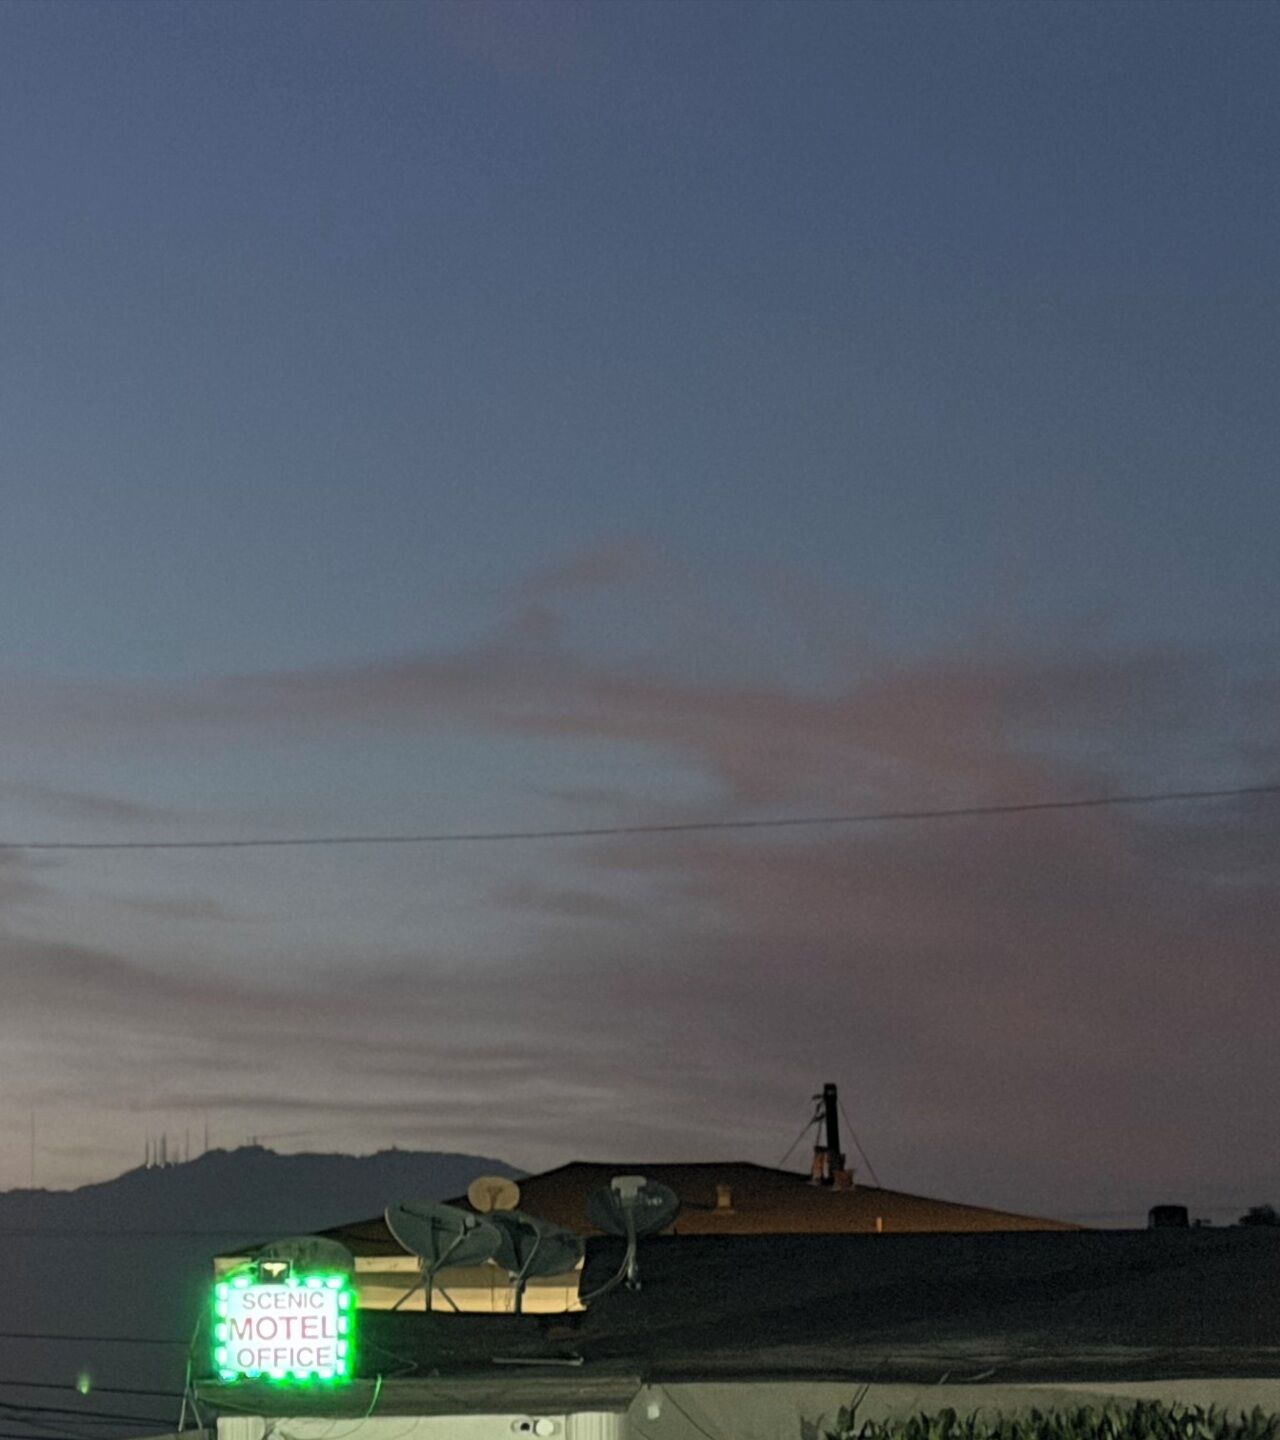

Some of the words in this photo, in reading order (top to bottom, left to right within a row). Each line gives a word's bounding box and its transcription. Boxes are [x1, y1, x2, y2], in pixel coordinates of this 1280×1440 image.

[243, 1291, 324, 1310] SCENIC
[229, 1316, 335, 1341] MOTEL
[237, 1347, 332, 1367] OFFICE
